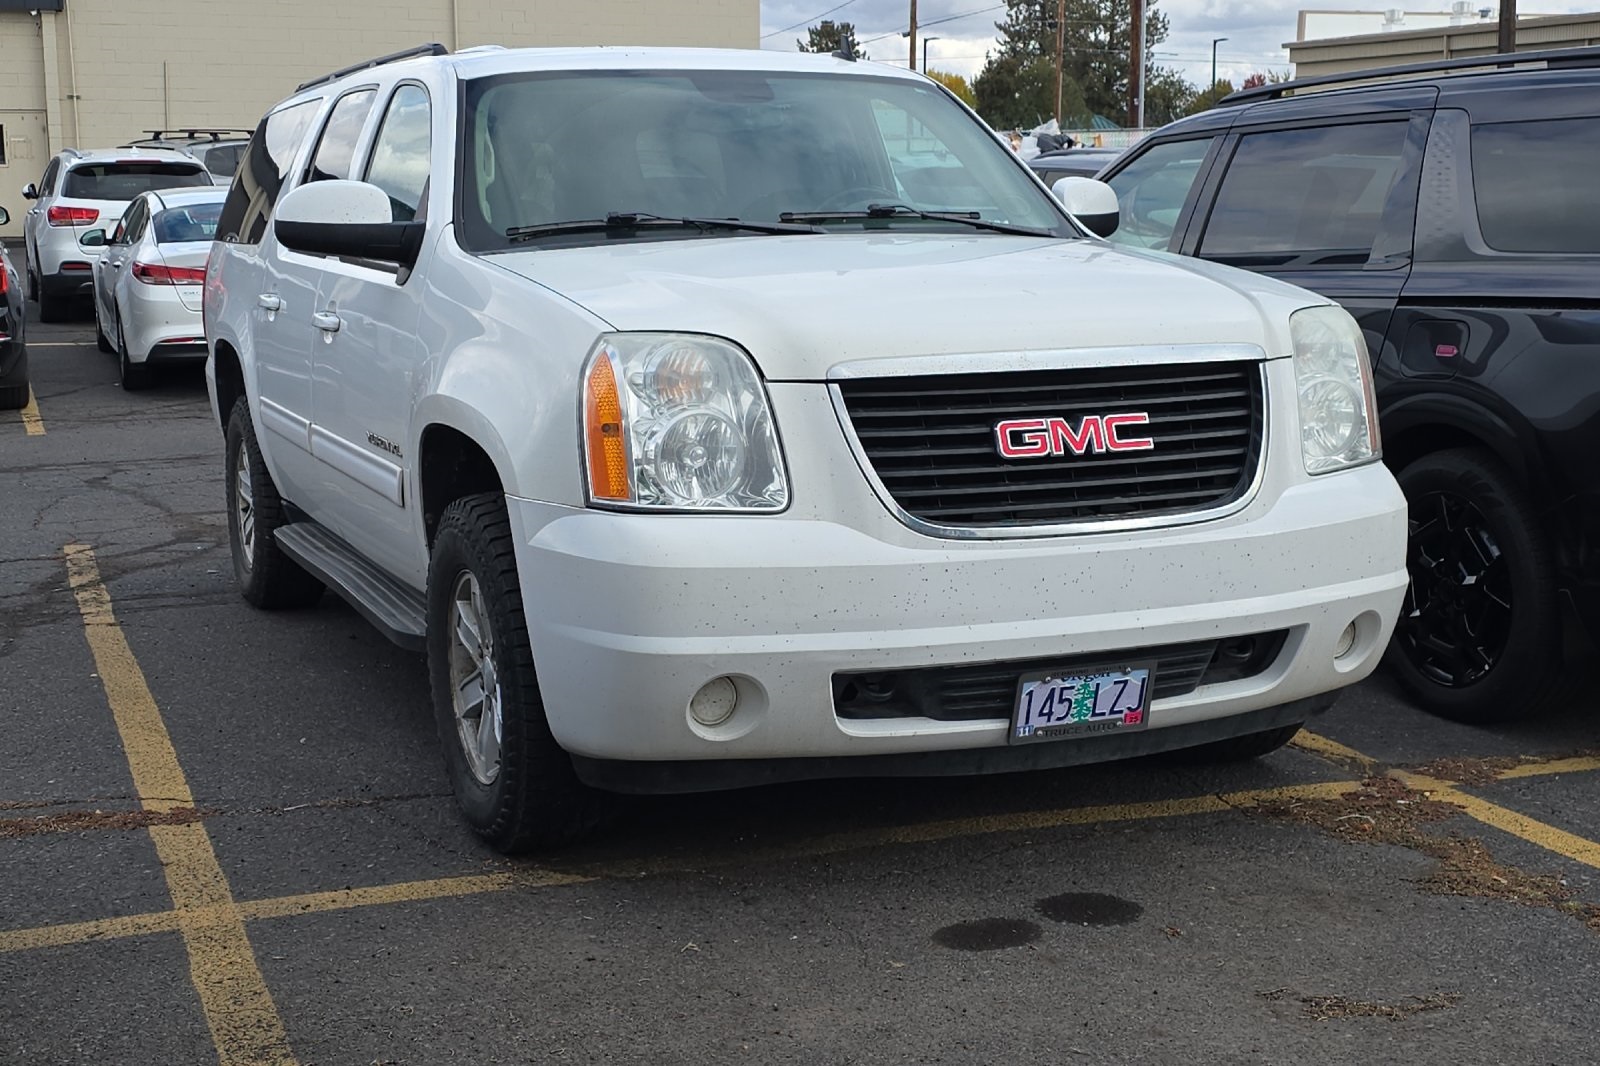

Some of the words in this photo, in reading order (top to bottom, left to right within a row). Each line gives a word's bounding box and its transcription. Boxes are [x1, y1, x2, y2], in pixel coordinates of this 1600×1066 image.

[996, 412, 1154, 458] GMC
[1025, 685, 1076, 725] 145
[1091, 677, 1146, 717] LZJ
[1044, 726, 1082, 738] TRUCE
[1086, 722, 1116, 733] AUTO
